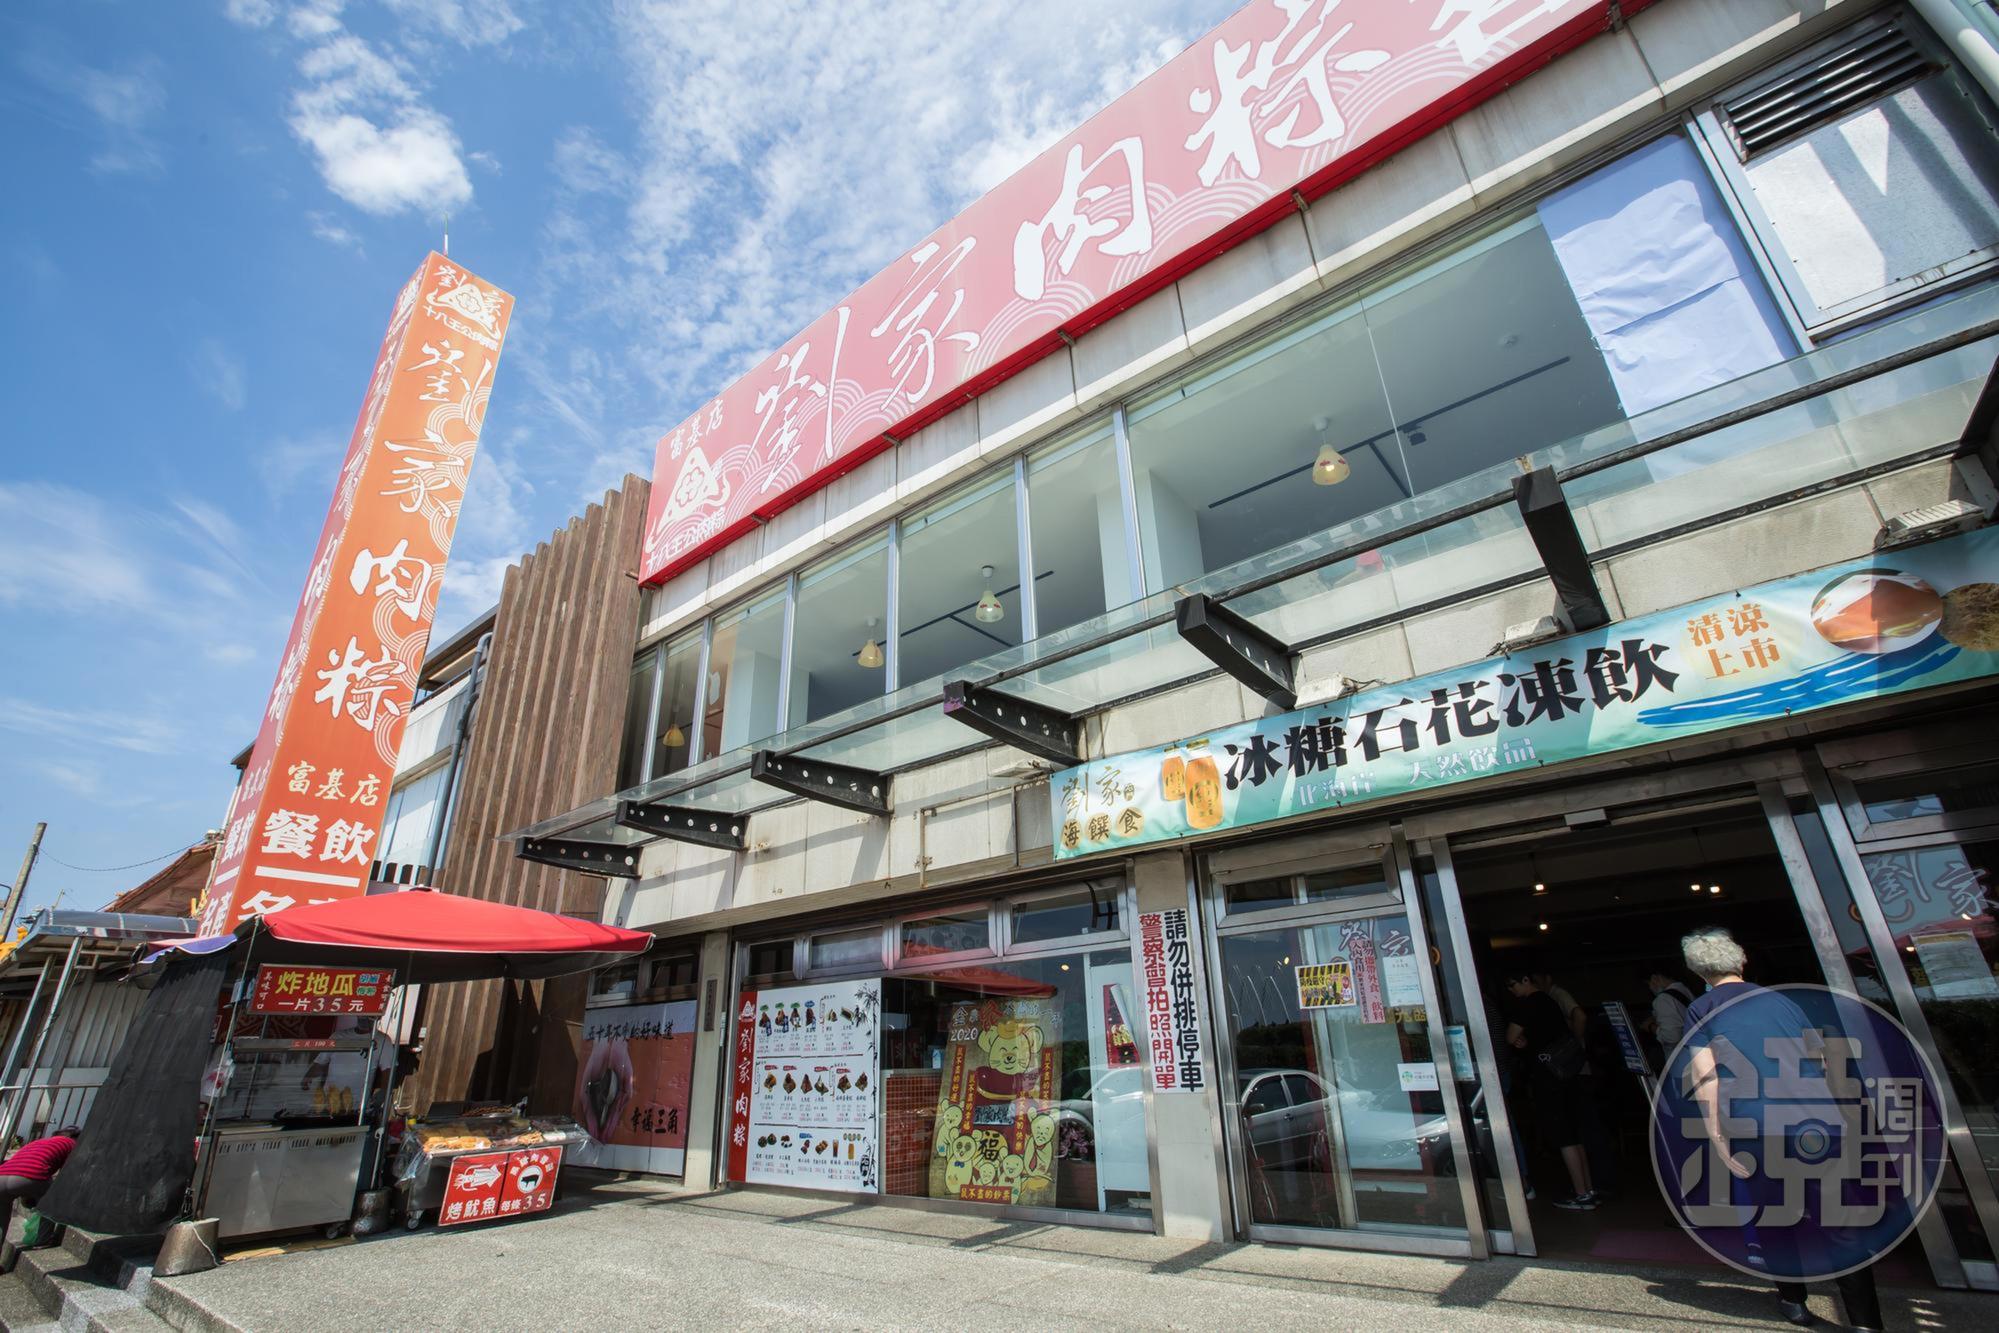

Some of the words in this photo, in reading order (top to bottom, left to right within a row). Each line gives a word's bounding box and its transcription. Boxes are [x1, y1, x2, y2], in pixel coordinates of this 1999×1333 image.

[1687, 602, 1771, 648] 清涼
[1704, 637, 1782, 681] 上市
[1223, 638, 1680, 791] 冰糖石花凍飲
[286, 760, 382, 808] 富基店
[260, 808, 375, 867] 餐飲
[275, 970, 357, 996] 炸地瓜
[278, 997, 365, 1013] 一片35元
[1164, 909, 1205, 1093] 請勿併排停車
[950, 1027, 978, 1042] 2020
[733, 1026, 754, 1147] 劉家肉粽
[978, 1130, 1001, 1161] 福
